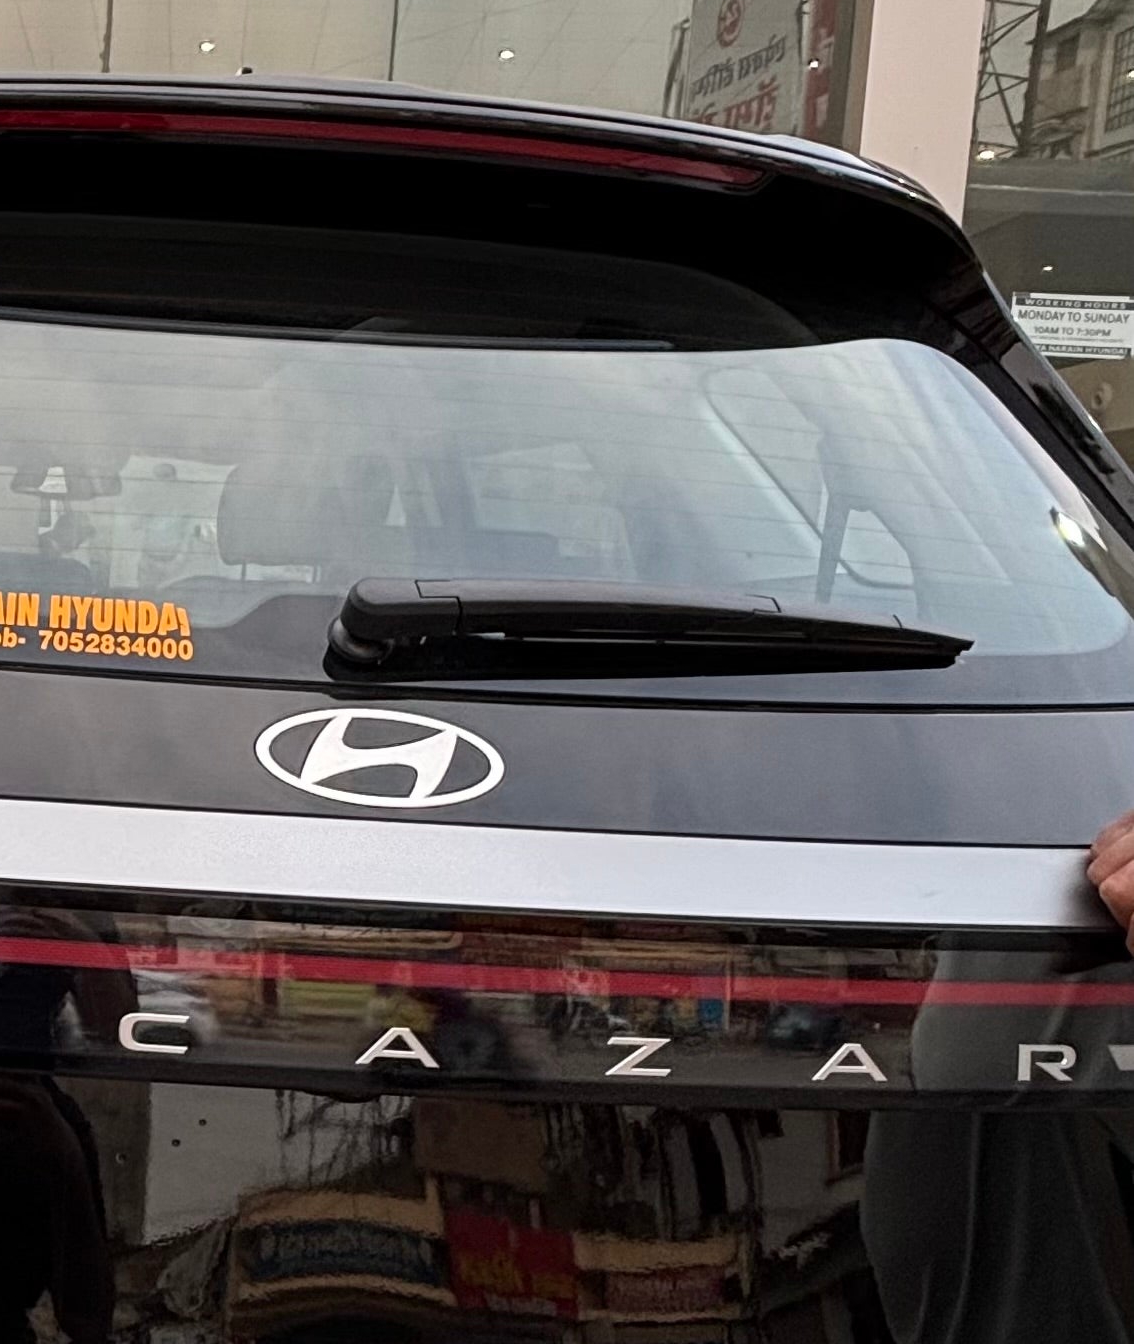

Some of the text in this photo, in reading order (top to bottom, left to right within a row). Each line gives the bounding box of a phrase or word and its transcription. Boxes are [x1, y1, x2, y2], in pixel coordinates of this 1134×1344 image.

[1025, 298, 1126, 309] WORKING HOURS
[1018, 309, 1130, 324] MONDAY TO SUNDAY
[1034, 326, 1059, 334] 10AM
[1062, 327, 1074, 335] TO
[38, 630, 194, 661] 7052834000
